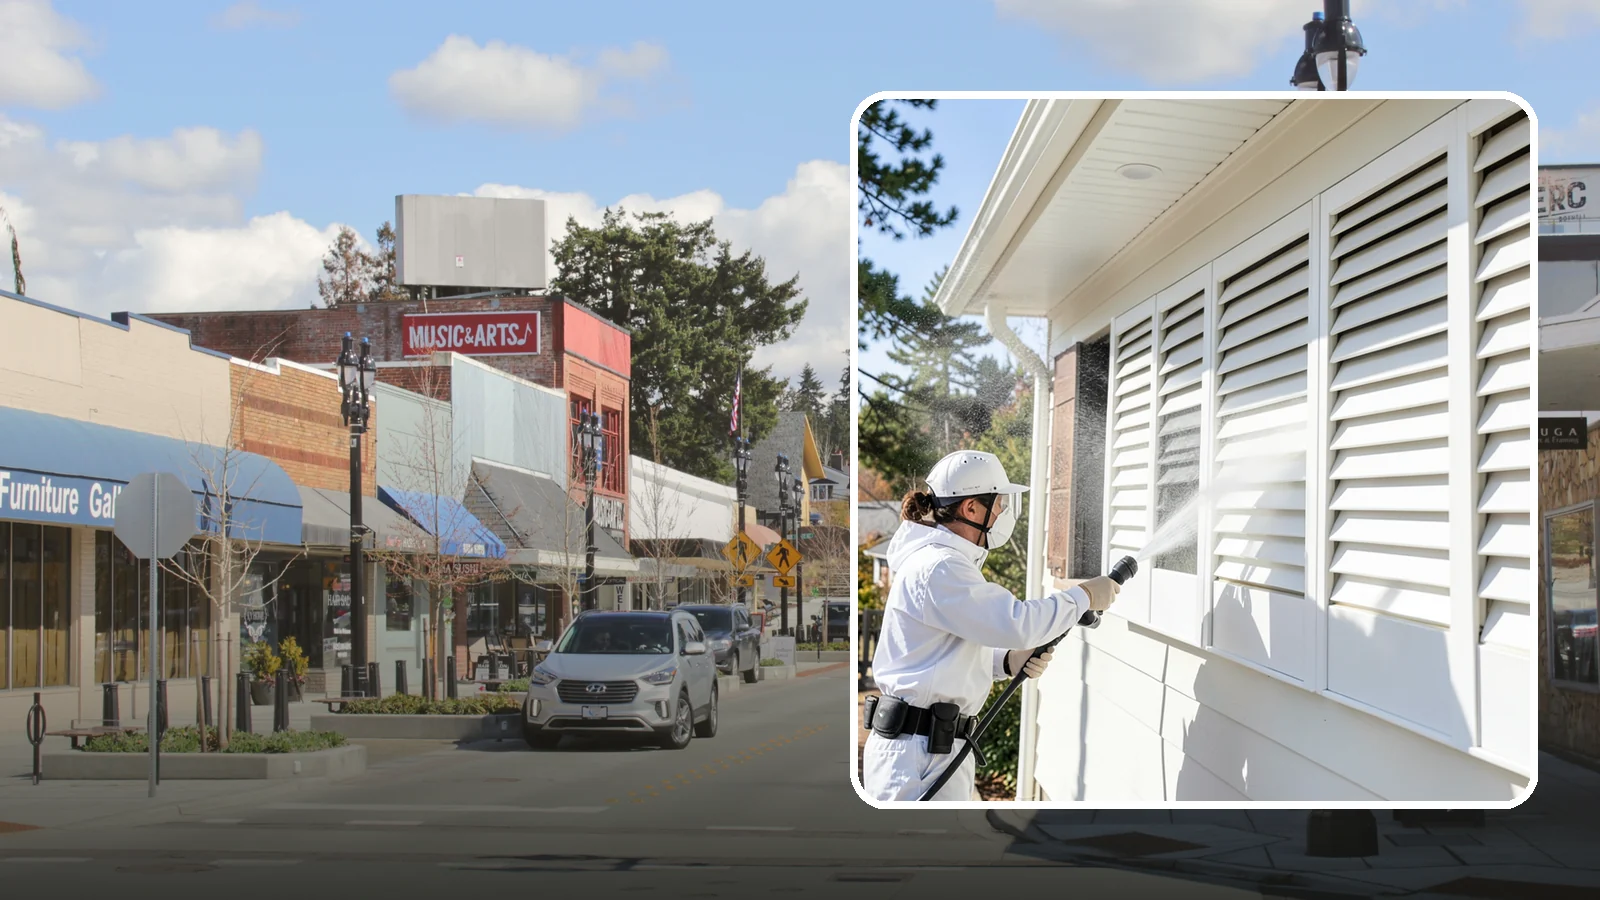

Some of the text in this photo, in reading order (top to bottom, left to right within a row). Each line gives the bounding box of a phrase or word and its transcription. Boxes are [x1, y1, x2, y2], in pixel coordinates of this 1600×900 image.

[0, 472, 121, 519] Furniture Gal
[453, 563, 479, 574] SUSHI
